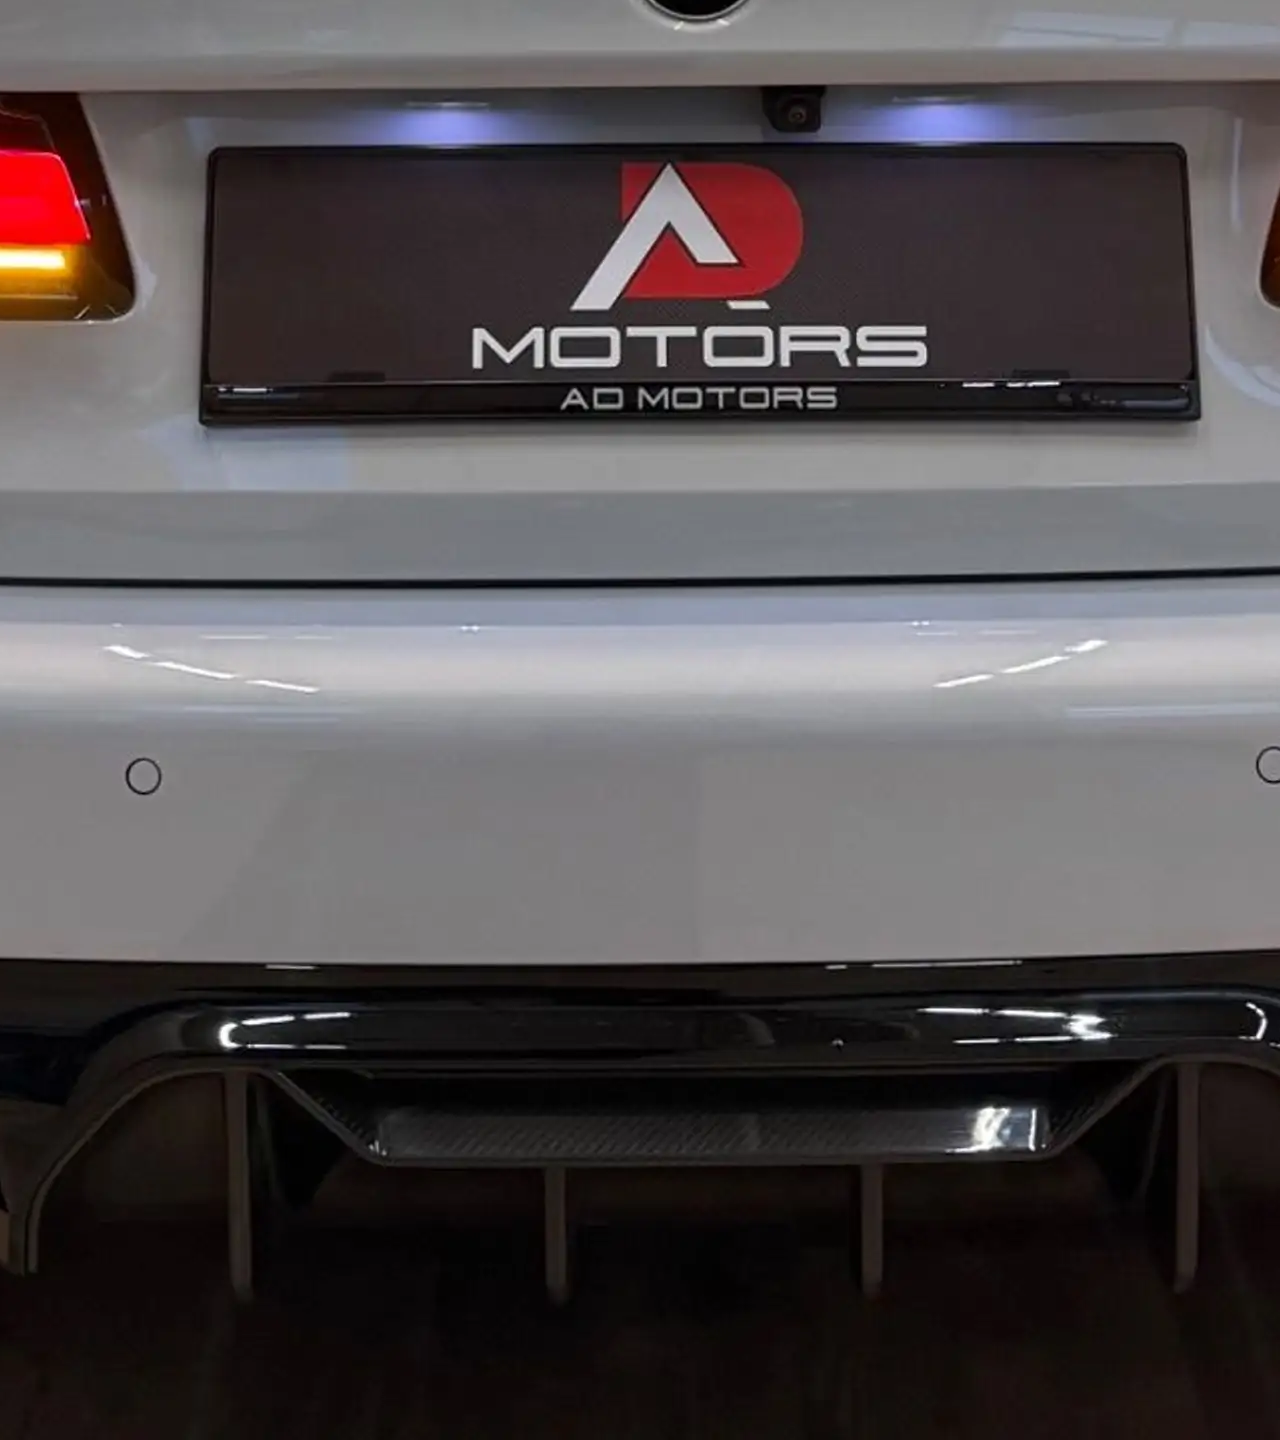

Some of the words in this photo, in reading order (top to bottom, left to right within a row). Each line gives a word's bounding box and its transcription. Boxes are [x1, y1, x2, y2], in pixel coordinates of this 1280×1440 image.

[472, 325, 928, 370] MOTORS
[560, 387, 625, 410] AD
[637, 386, 838, 410] MOTORS
